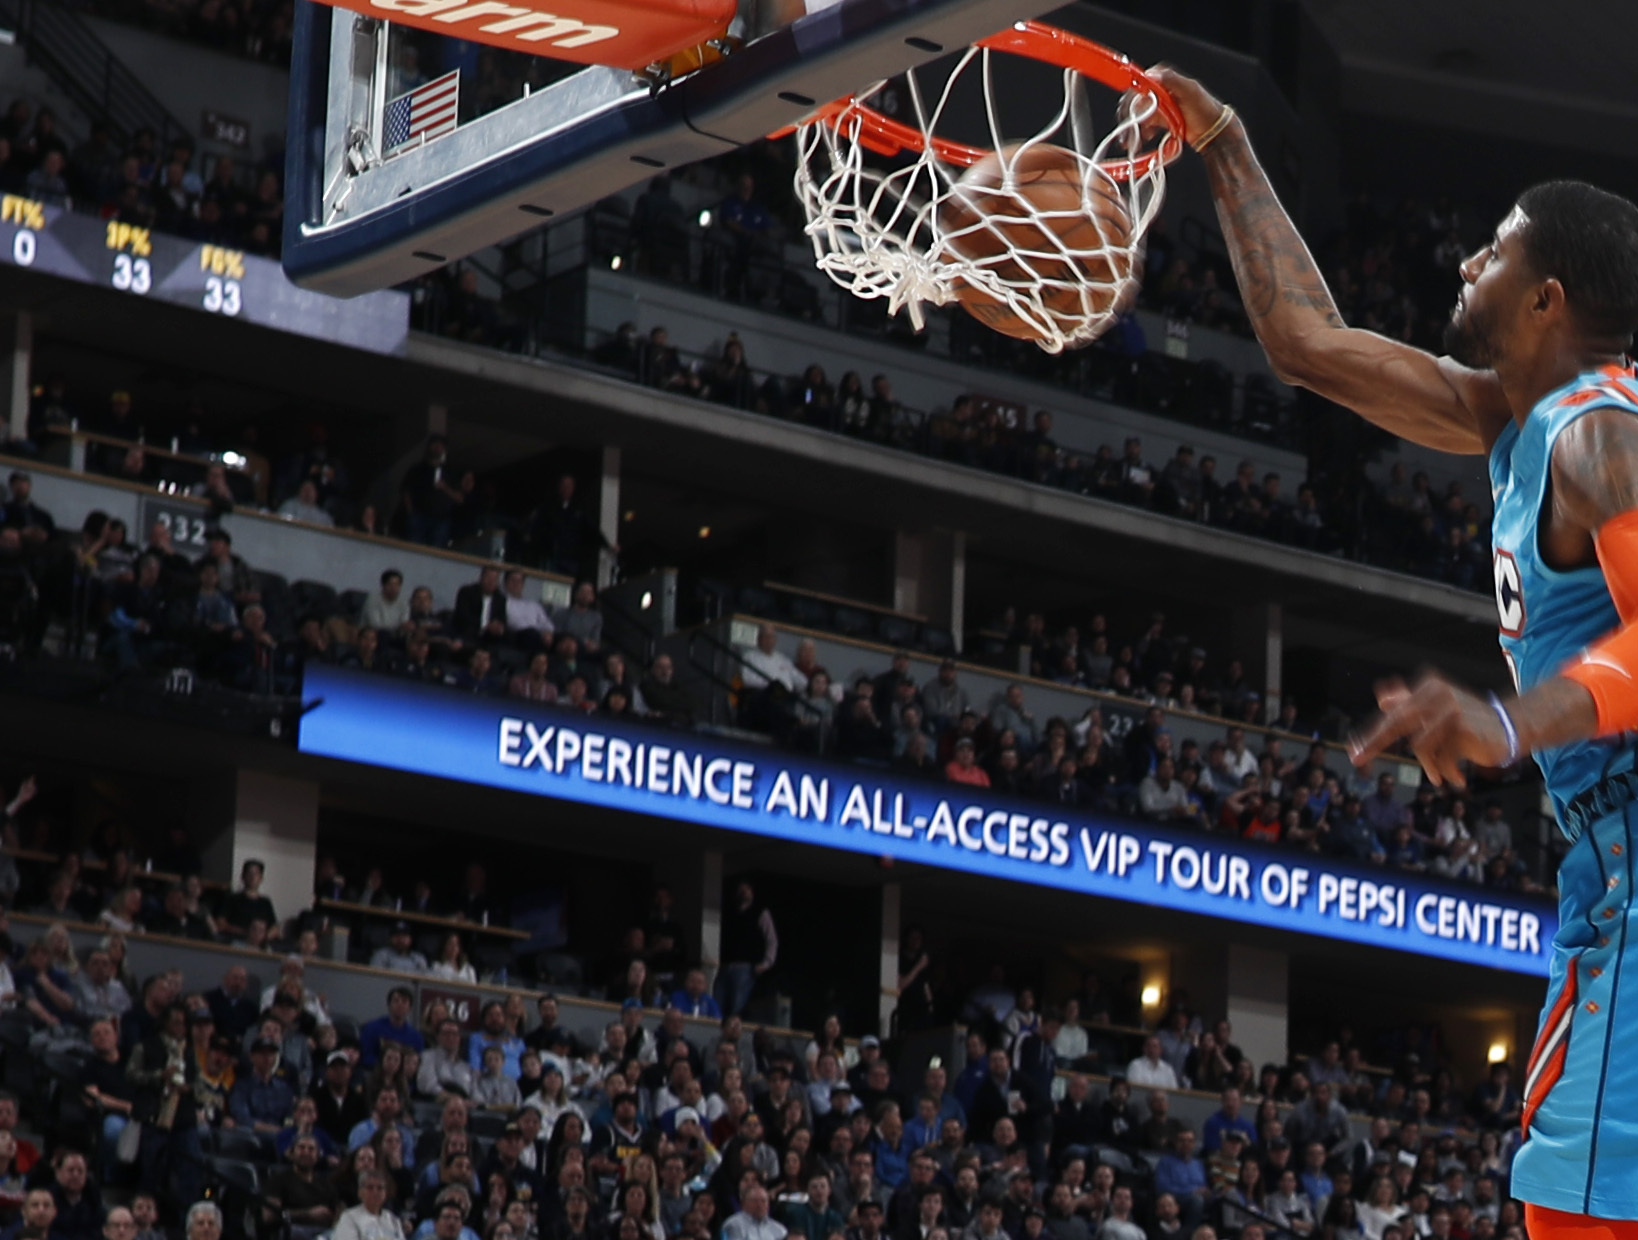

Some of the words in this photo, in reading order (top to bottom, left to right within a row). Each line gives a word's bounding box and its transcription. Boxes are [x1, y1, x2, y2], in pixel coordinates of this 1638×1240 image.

[13, 229, 36, 266] 0
[112, 254, 152, 295] 33
[203, 277, 242, 317] 33
[499, 717, 755, 809] EXPERIENCE
[765, 770, 829, 822] AN
[840, 785, 1070, 866] ALL-ACCESS
[1080, 827, 1140, 876] VIP
[1148, 840, 1250, 900] TOUR
[1260, 863, 1308, 908] OF
[1318, 872, 1406, 928] PEPSI
[1415, 893, 1541, 955] CENTER
